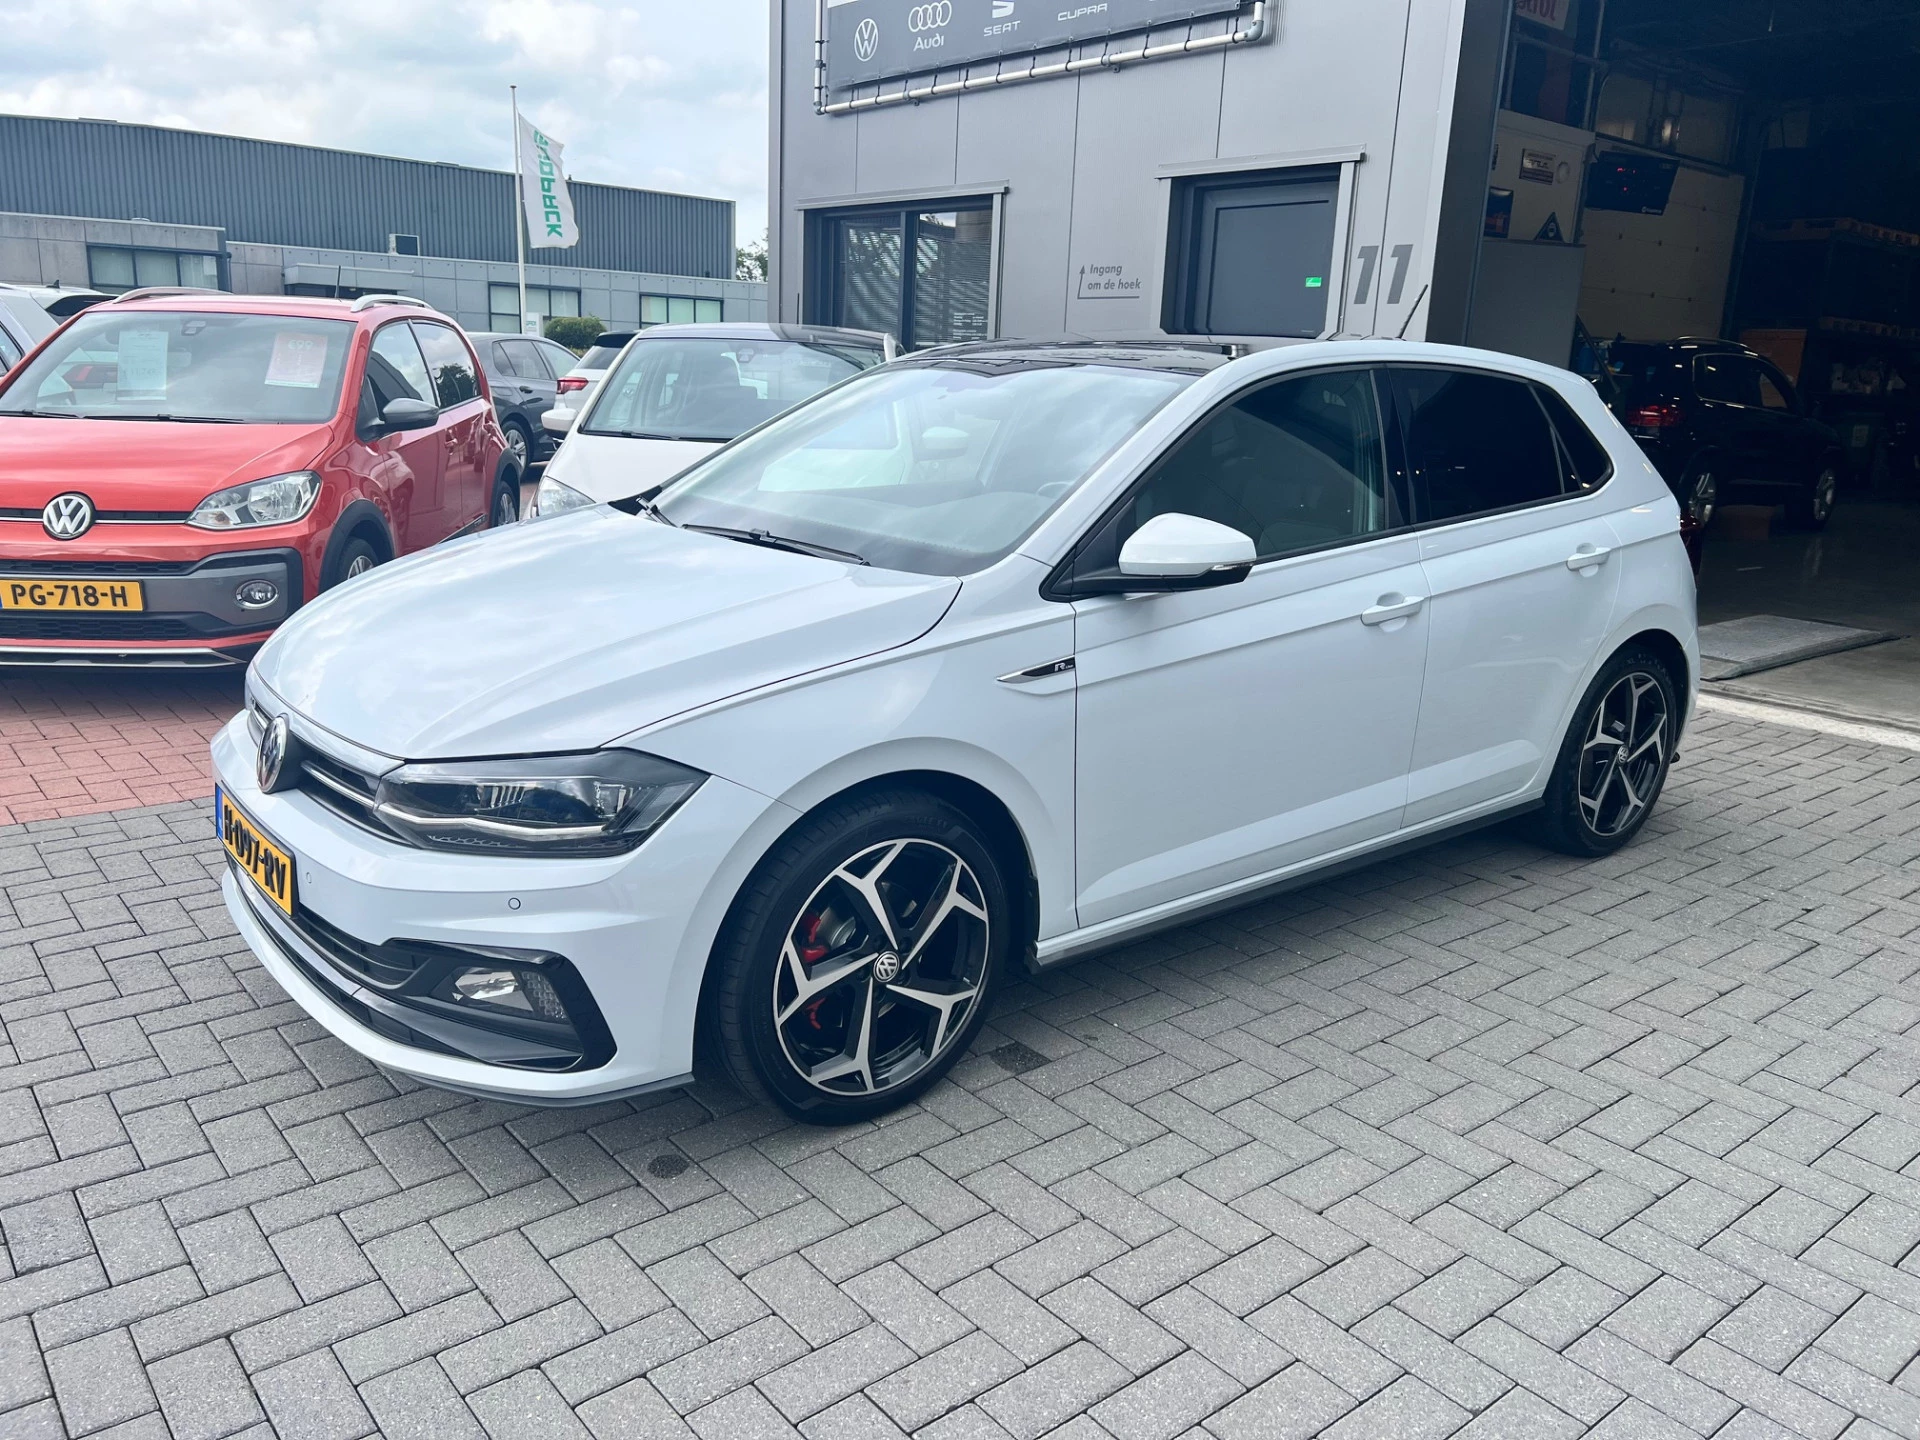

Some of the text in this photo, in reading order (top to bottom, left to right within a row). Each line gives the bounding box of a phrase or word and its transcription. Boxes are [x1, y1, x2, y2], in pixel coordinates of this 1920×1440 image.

[1057, 3, 1108, 21] CUPRA
[983, 20, 1021, 37] SEAT
[913, 35, 945, 52] Audi
[1090, 264, 1122, 276] Ingang
[1353, 244, 1414, 305] 11
[1087, 277, 1141, 290] om de hoek
[10, 584, 129, 607] PG-718-H
